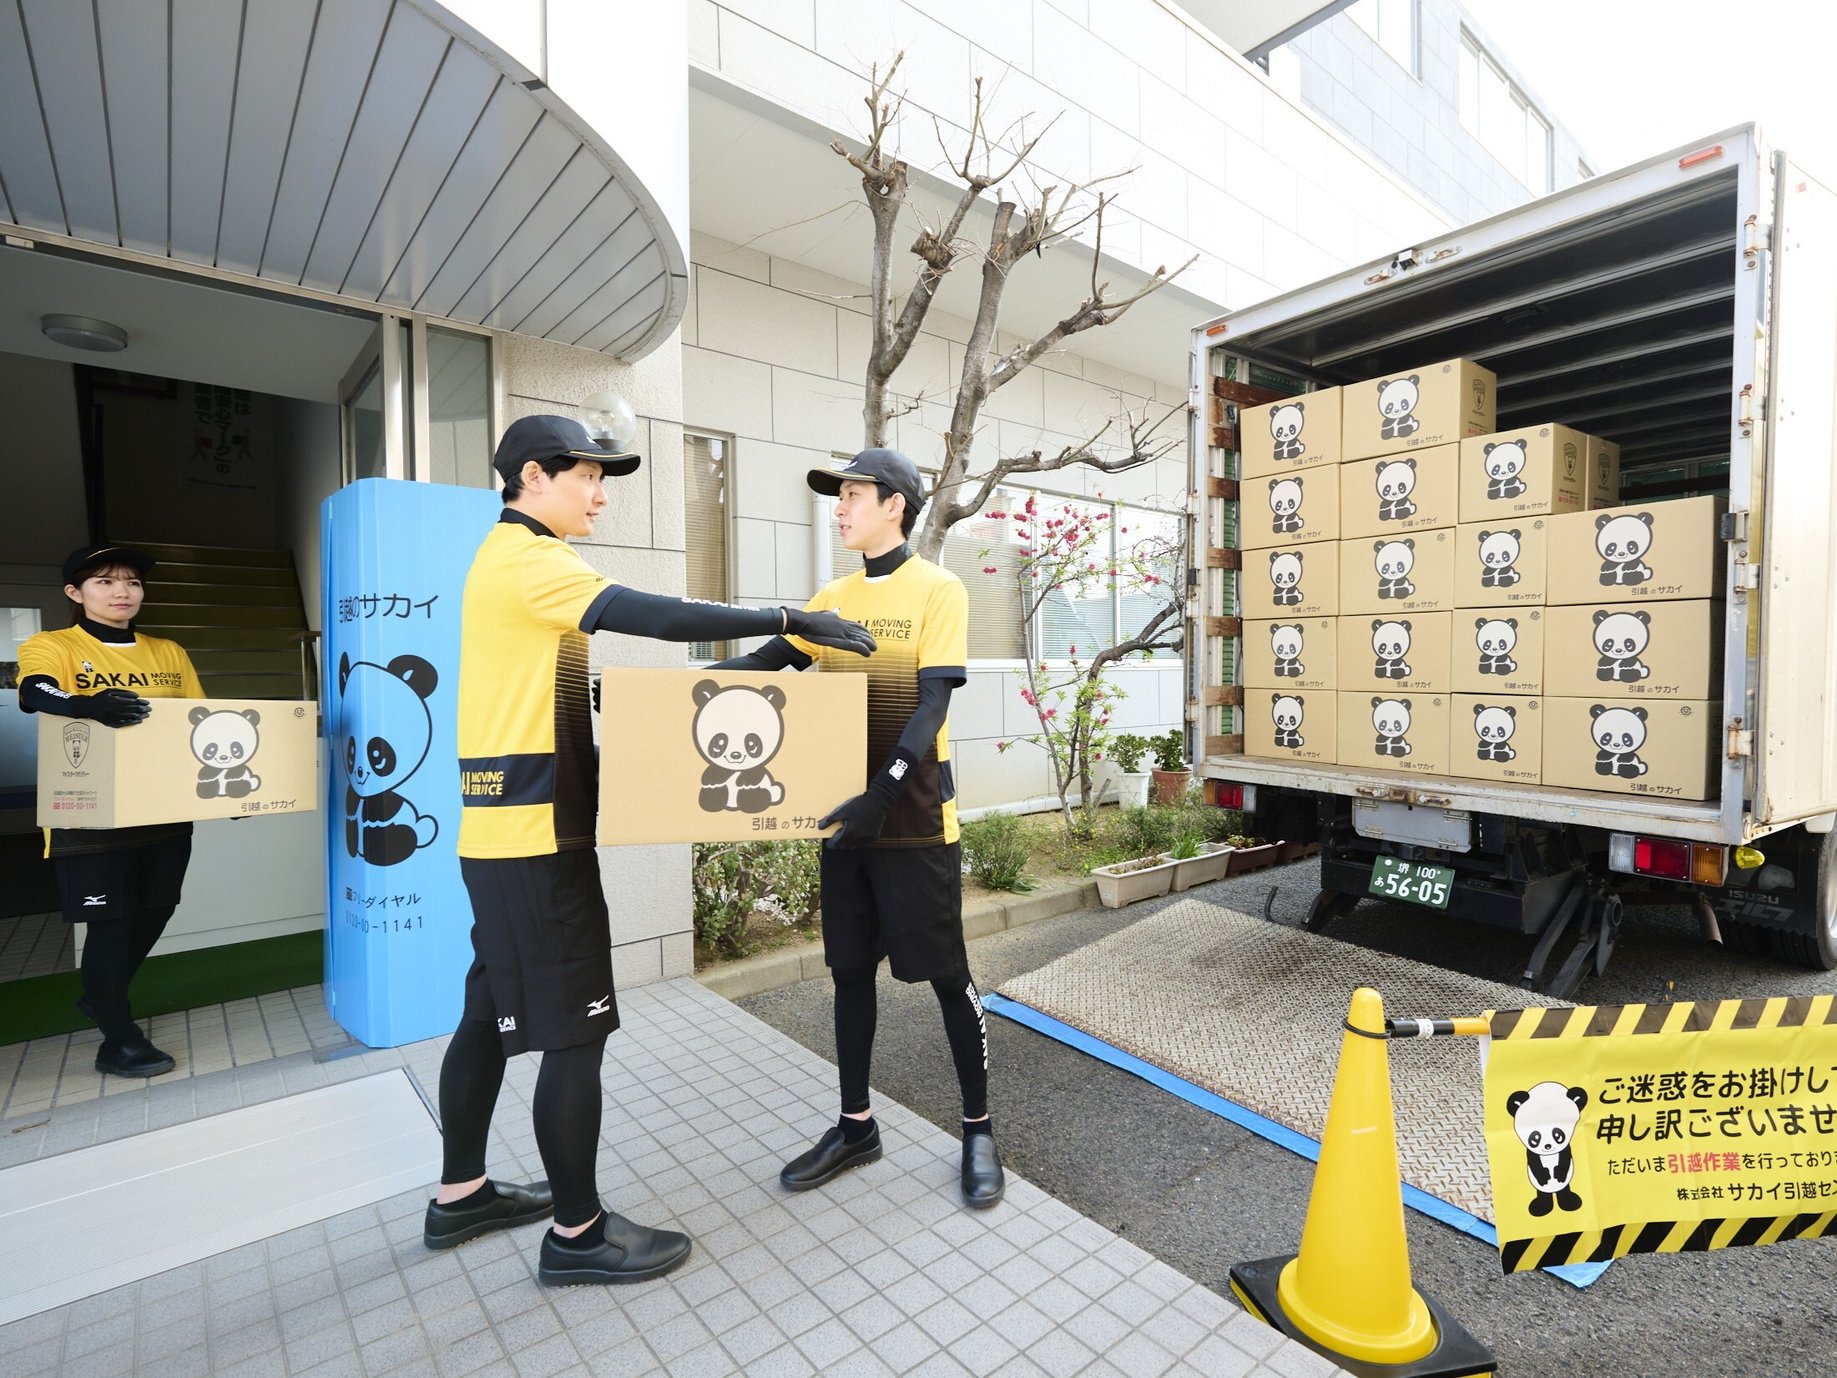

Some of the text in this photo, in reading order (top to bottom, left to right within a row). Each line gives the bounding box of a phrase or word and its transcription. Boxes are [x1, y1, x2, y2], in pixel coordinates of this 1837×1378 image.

[1631, 585, 1684, 596] 引越のサカイ
[338, 593, 439, 623] 引越のサカイ
[871, 619, 912, 629] MOVING
[870, 629, 911, 639] SERVICE
[75, 672, 182, 689] SAKAI MOVING
[153, 679, 182, 687] SERVICE
[1628, 685, 1680, 694] 引越のサカイ
[1630, 783, 1682, 795] 引越のサカイ
[241, 799, 297, 812] 引越のサカイ
[752, 816, 821, 831] 引越のサカ
[1416, 866, 1436, 879] 100
[1374, 873, 1447, 905] あ 56-05
[1729, 889, 1779, 904] ISUZU
